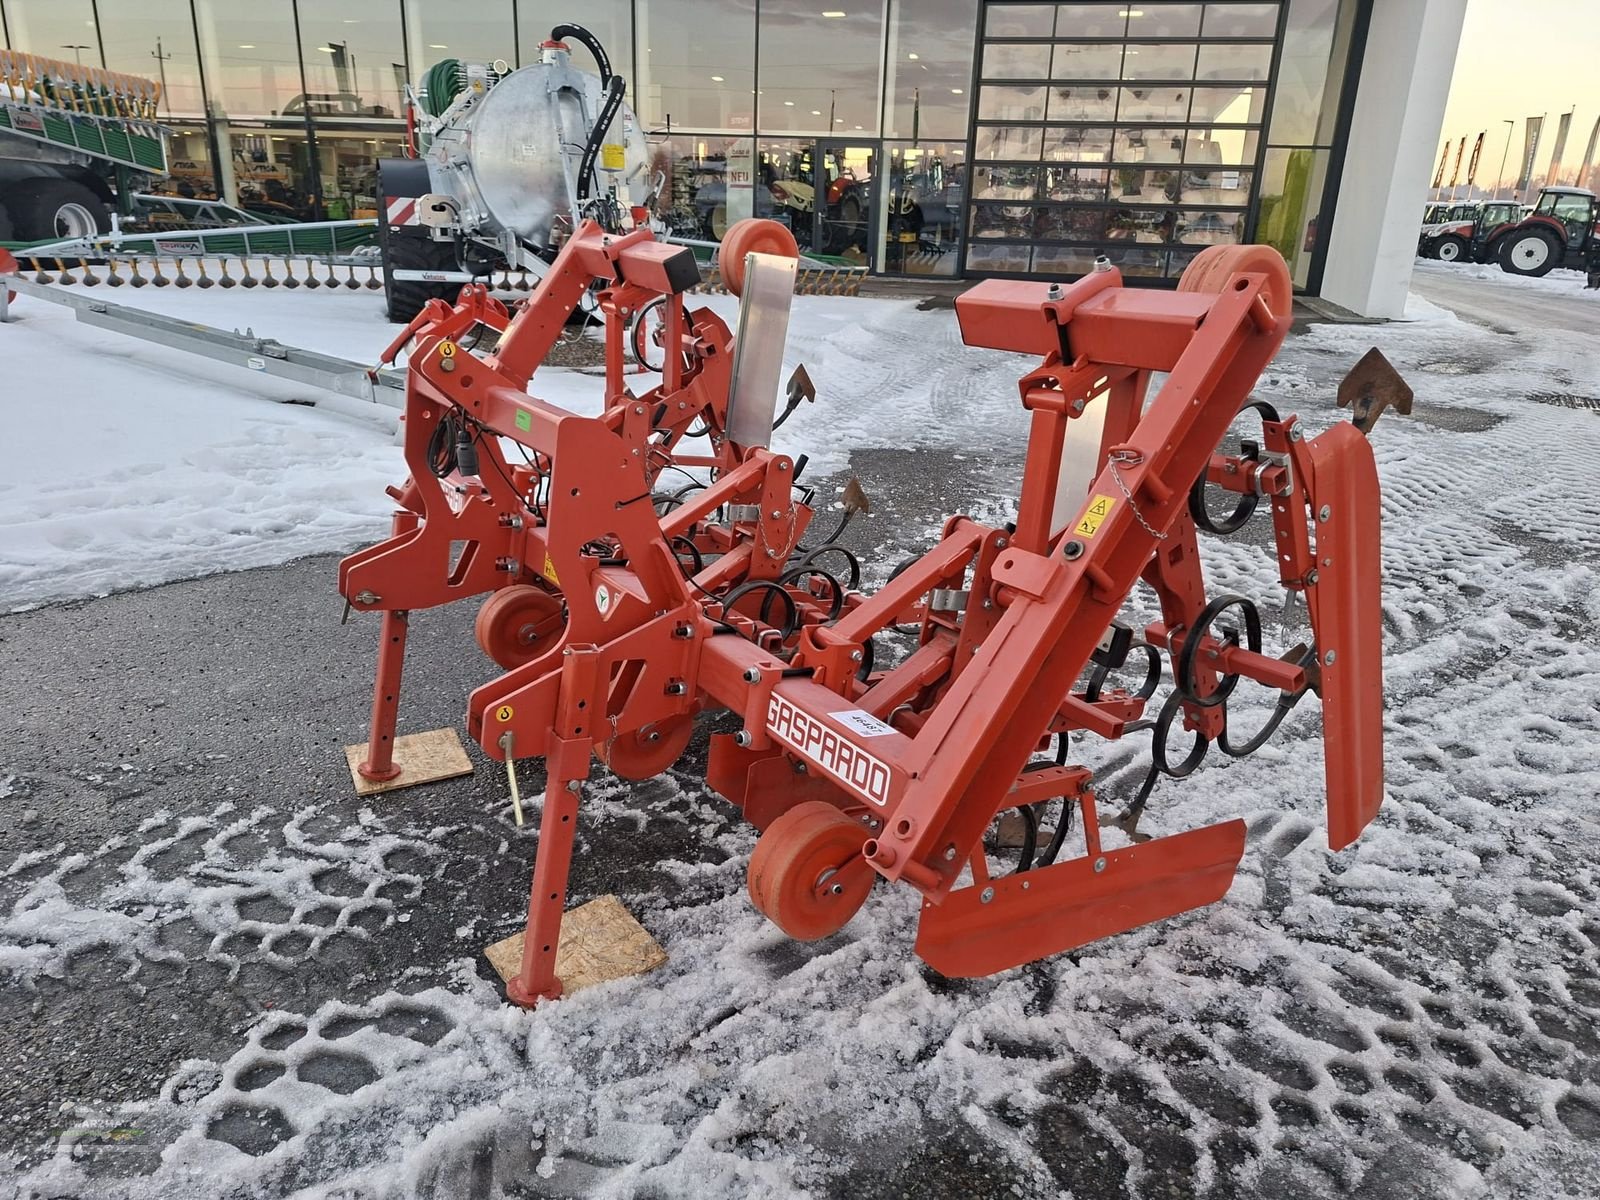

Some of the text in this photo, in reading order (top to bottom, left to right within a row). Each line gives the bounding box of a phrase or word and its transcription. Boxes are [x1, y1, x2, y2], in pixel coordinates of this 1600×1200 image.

[173, 161, 197, 169] STIGA
[731, 171, 749, 182] NEU
[767, 696, 889, 803] GASPARDO
